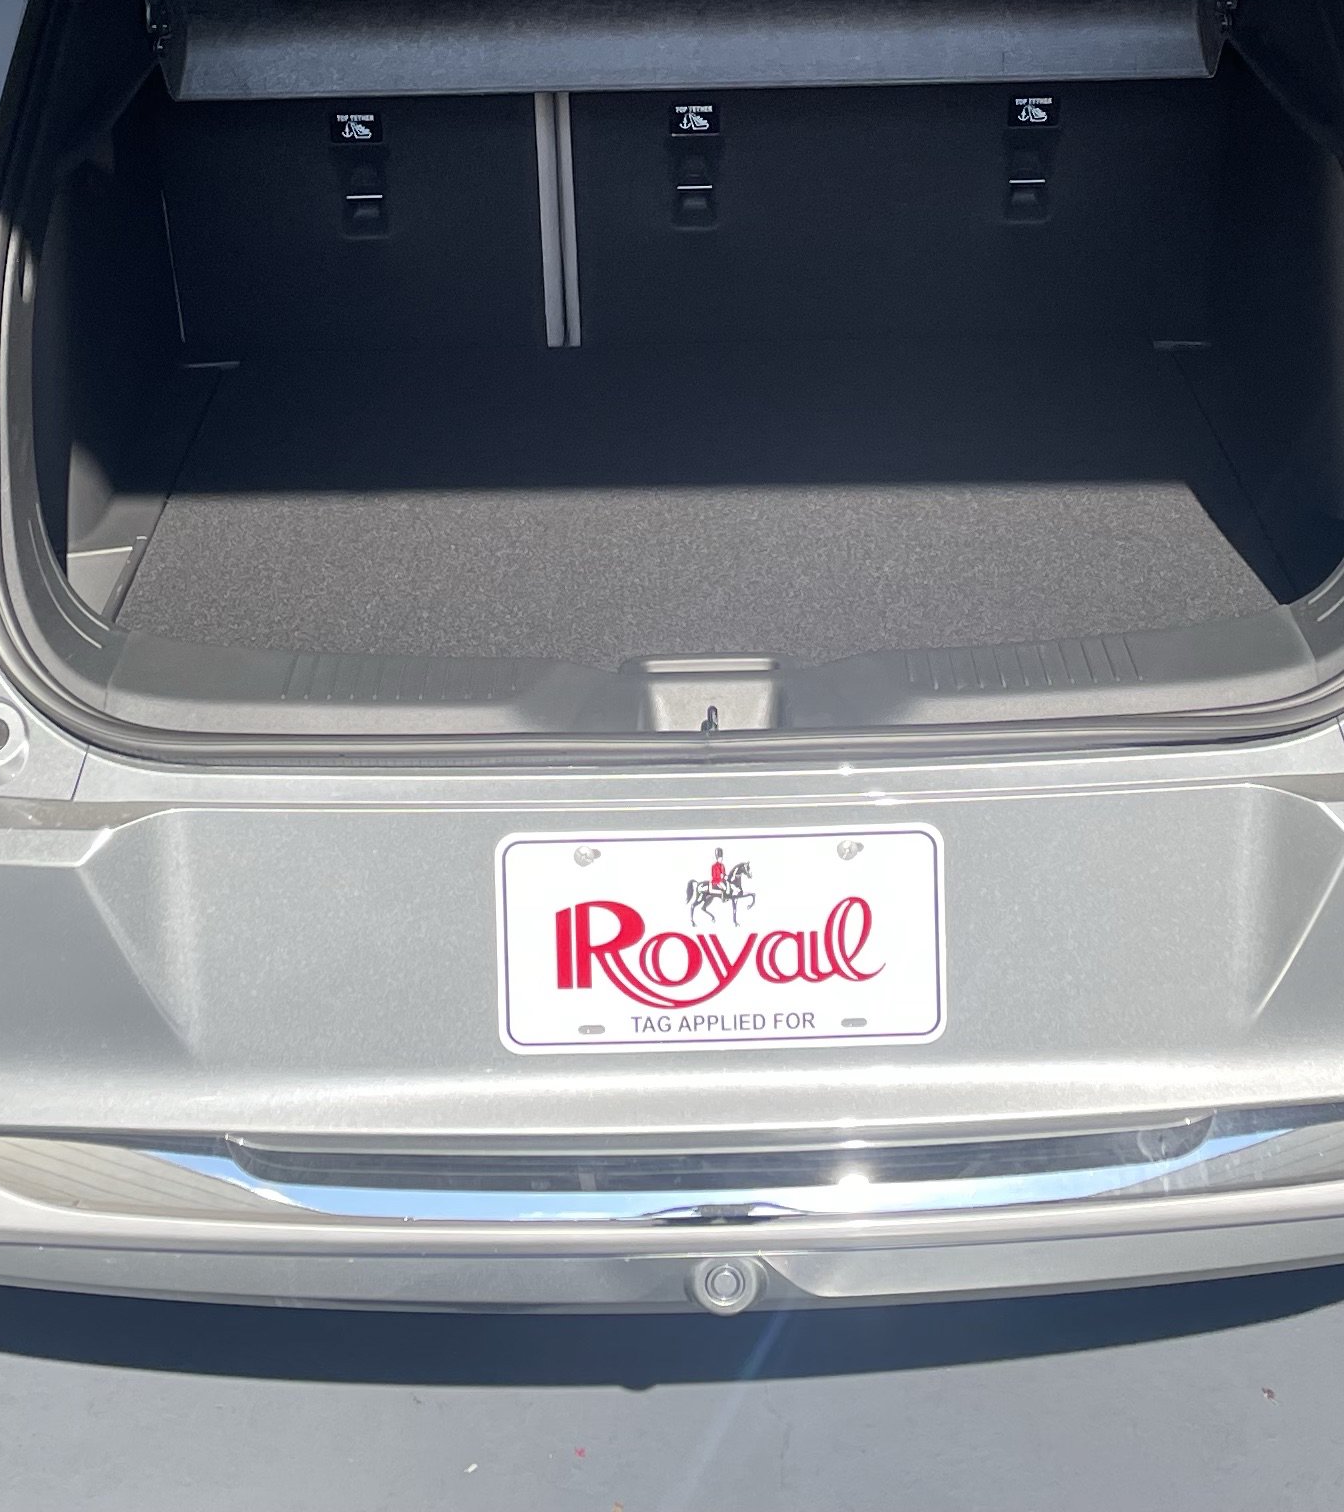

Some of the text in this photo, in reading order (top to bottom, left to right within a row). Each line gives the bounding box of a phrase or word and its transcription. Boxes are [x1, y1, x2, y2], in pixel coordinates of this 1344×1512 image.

[555, 896, 886, 1009] Royal
[631, 1012, 816, 1033] TAG APPLIED FOR
